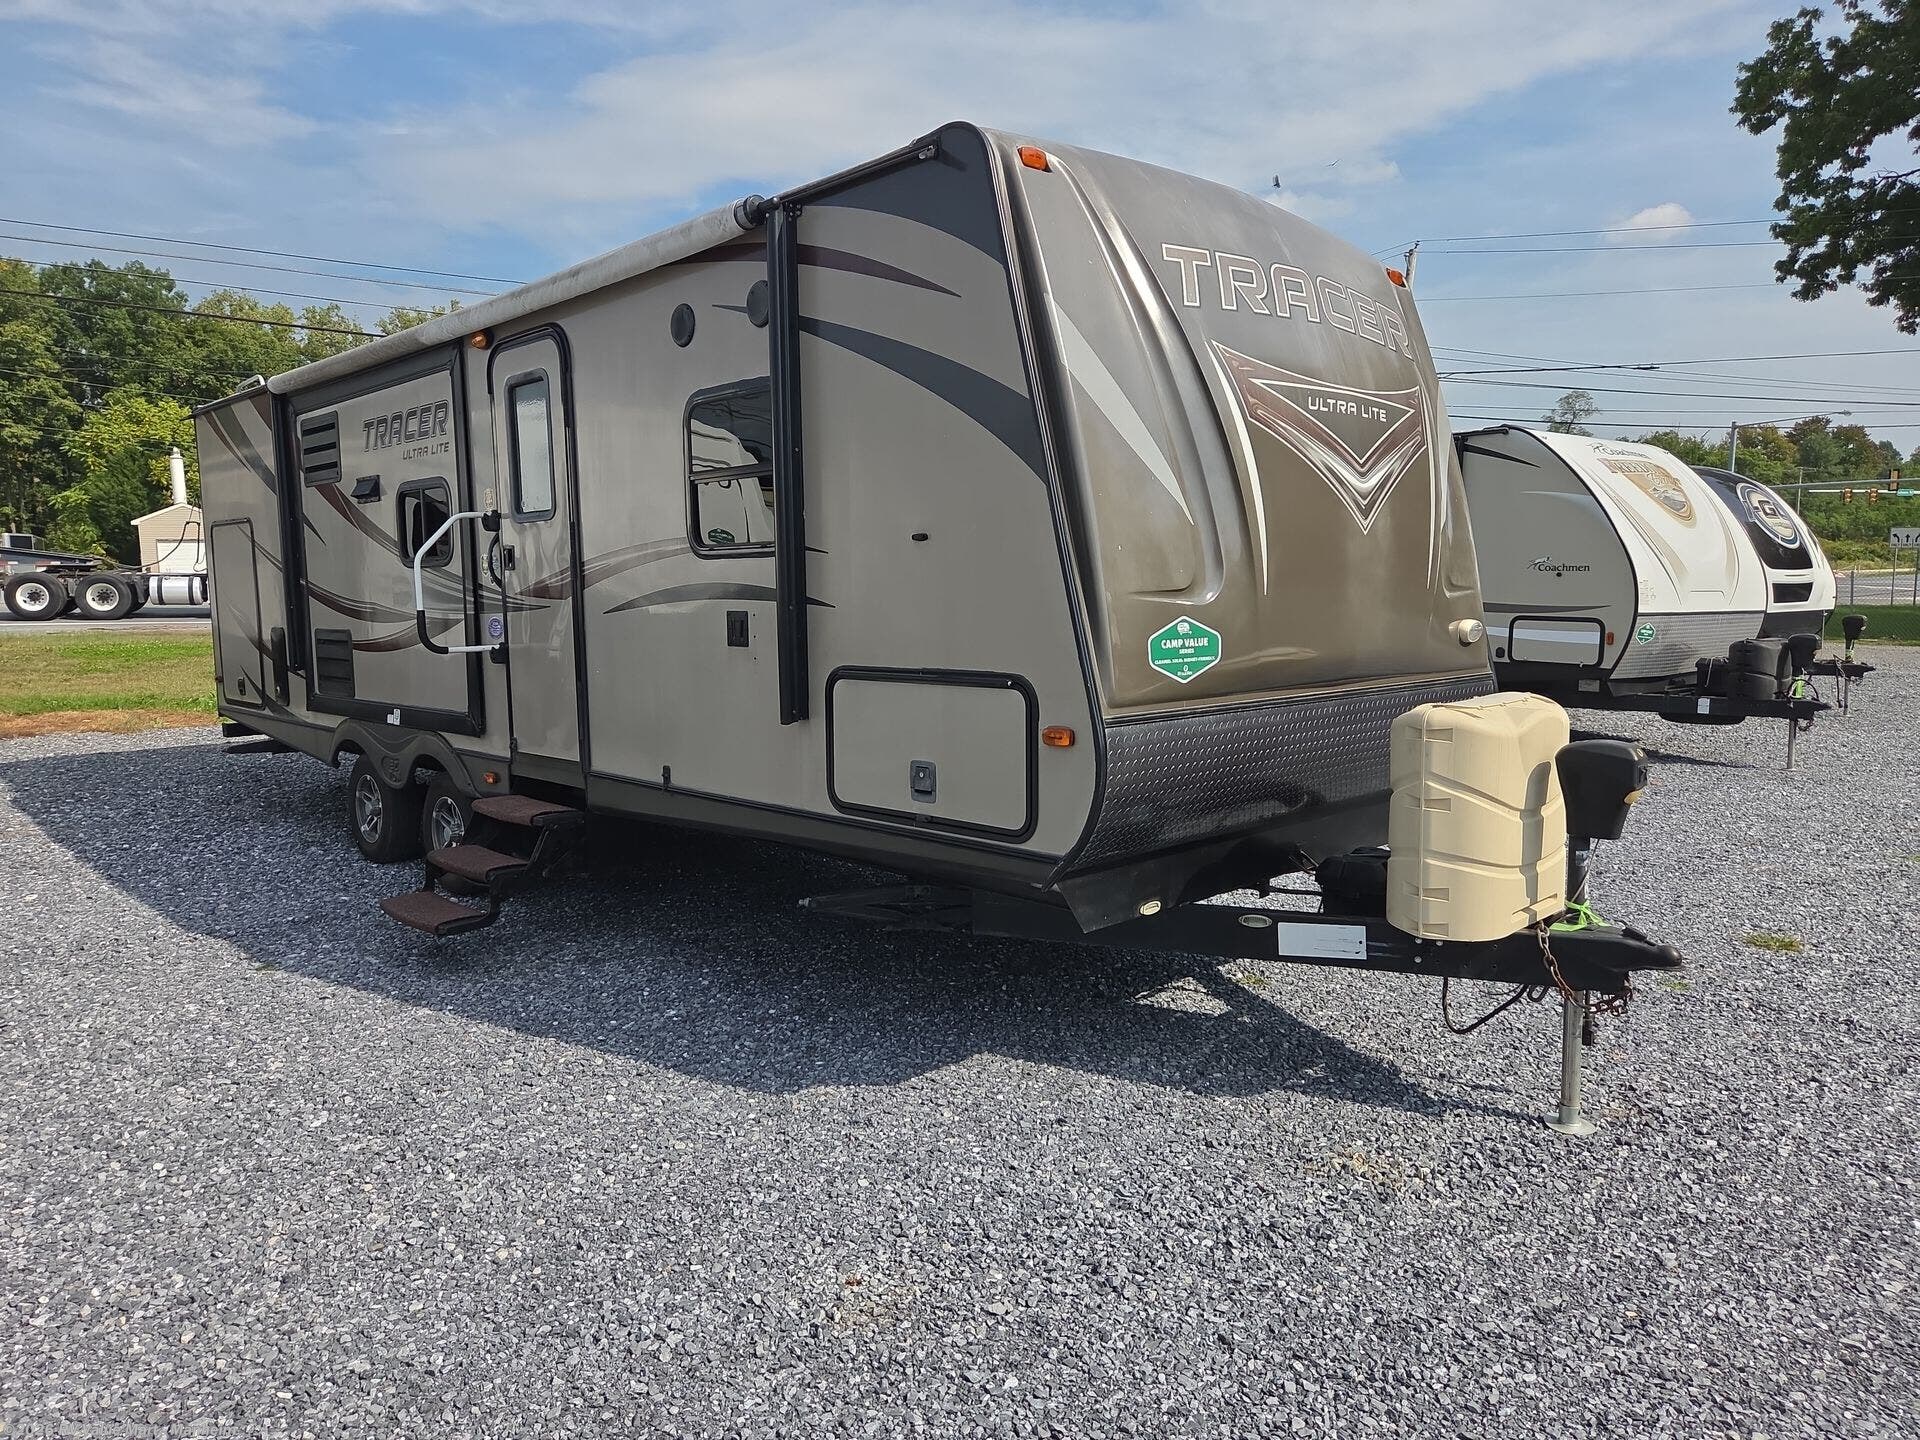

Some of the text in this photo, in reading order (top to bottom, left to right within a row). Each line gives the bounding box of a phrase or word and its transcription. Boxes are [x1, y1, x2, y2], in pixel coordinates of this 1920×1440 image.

[1161, 243, 1415, 362] TRACER
[1308, 396, 1387, 422] ULTRA LITE
[362, 399, 449, 453] TRACER
[402, 441, 450, 461] ULTRA LITE
[1538, 563, 1590, 572] Coachmen
[1161, 637, 1208, 649] CAMP VALUE
